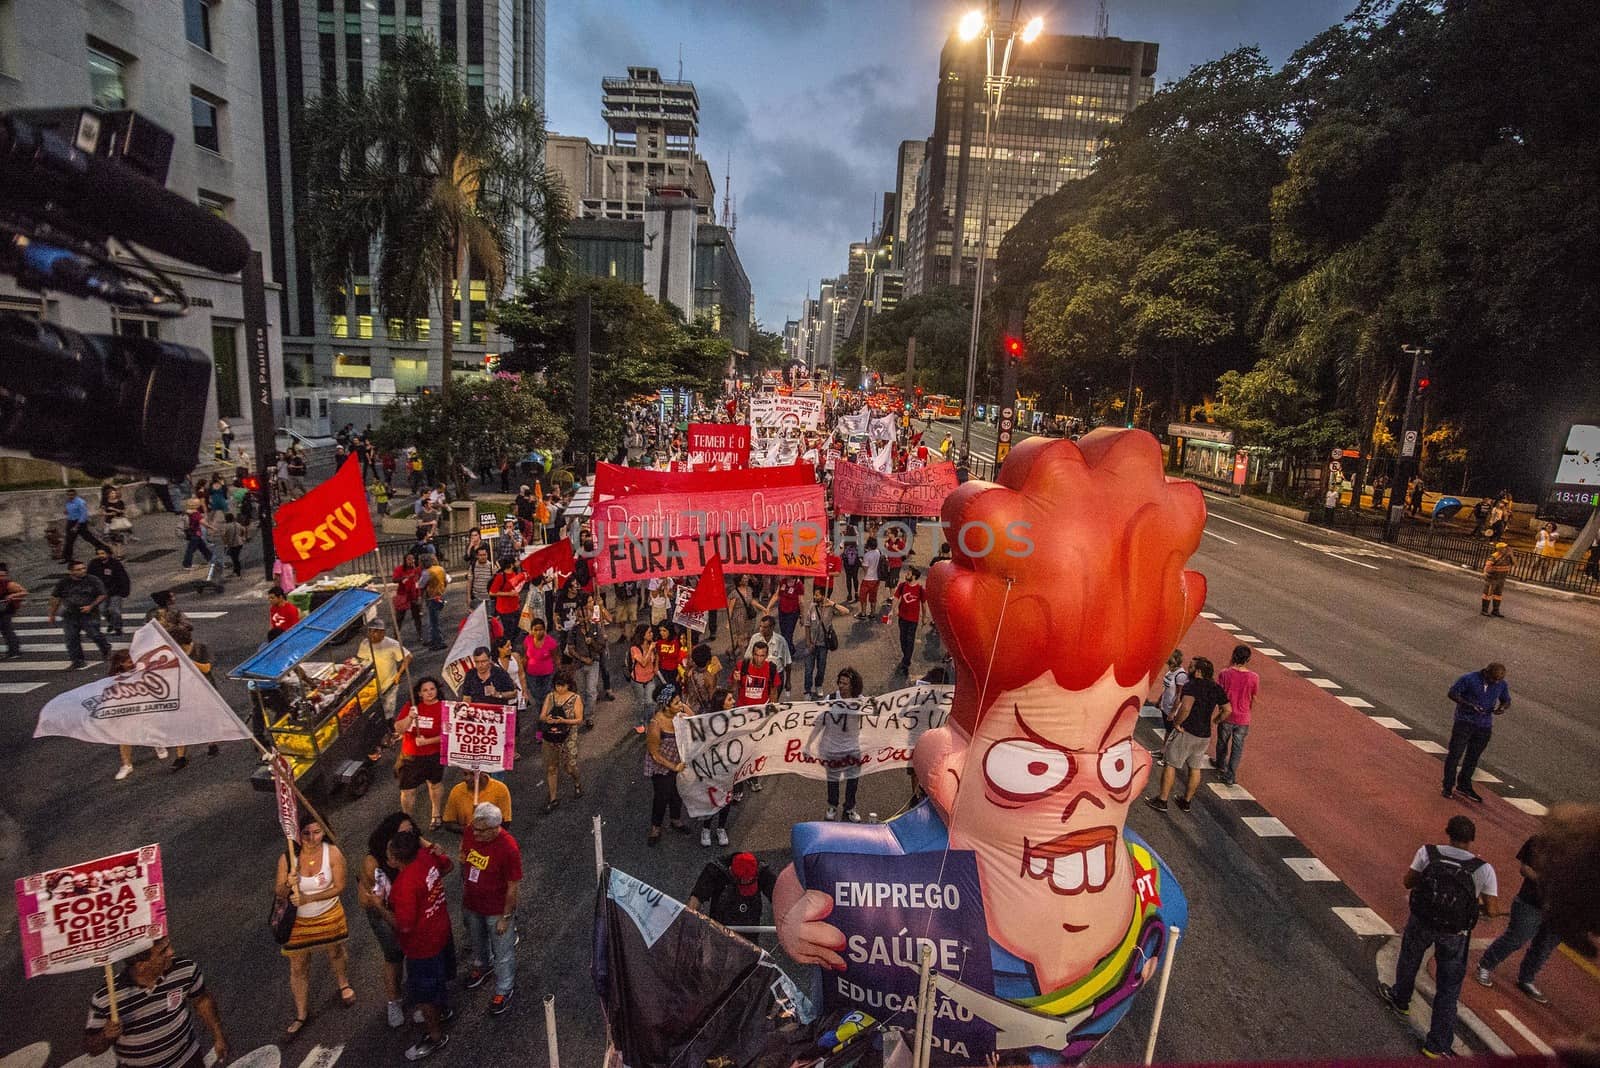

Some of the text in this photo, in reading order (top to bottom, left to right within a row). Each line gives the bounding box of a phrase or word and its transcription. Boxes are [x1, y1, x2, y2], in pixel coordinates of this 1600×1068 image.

[257, 328, 269, 405] Av Paulista
[801, 410, 812, 418] PT
[693, 434, 725, 449] TEMER
[729, 434, 734, 449] É
[738, 436, 745, 449] O
[1555, 491, 1590, 503] 18:16
[291, 501, 357, 560] PSTU
[610, 531, 779, 579] FORA TODOS
[455, 722, 498, 736] FORA
[455, 733, 498, 746] TODOS
[459, 743, 492, 755] ELES!
[692, 738, 744, 782] NÃO
[859, 709, 920, 731] NAS
[53, 884, 136, 921] FORA
[835, 881, 960, 910] EMPREGO
[1136, 873, 1155, 902] PT
[54, 899, 138, 934] TODOS
[67, 915, 130, 946] ELES!
[848, 927, 960, 972] SAÚDE
[837, 976, 974, 1023] EDUCAÃO
